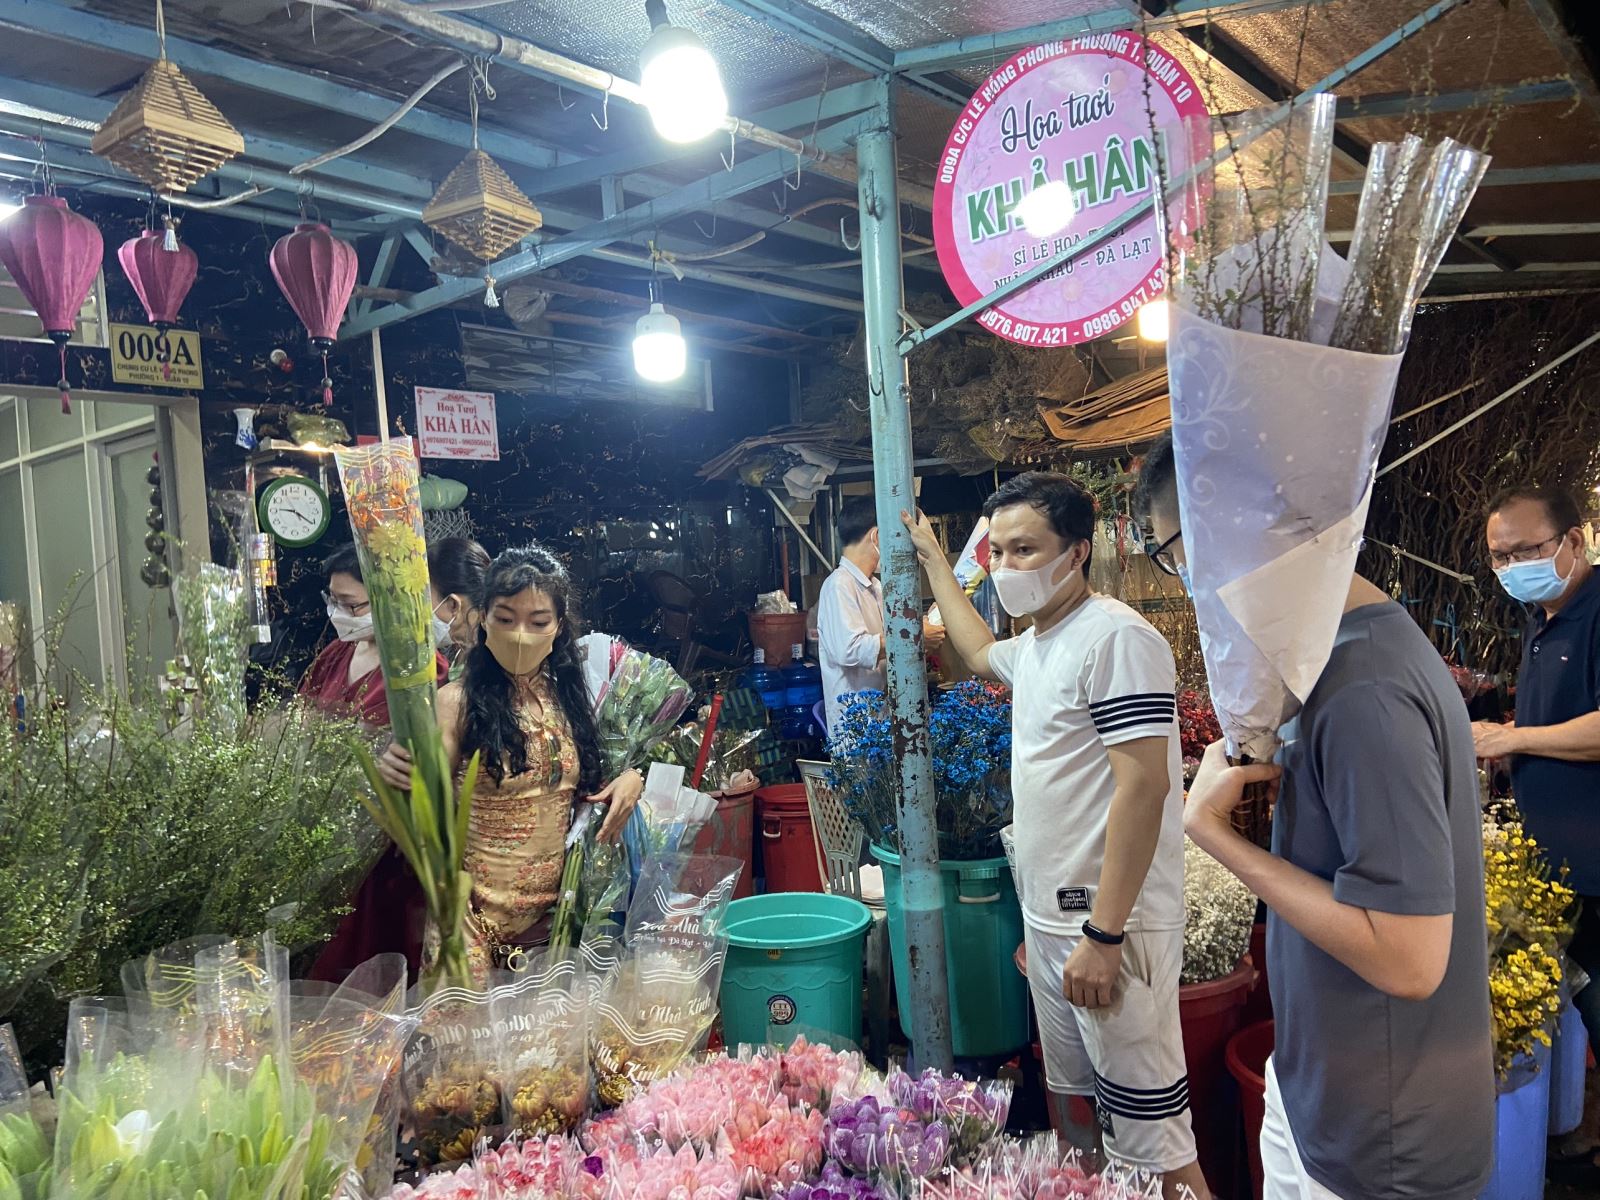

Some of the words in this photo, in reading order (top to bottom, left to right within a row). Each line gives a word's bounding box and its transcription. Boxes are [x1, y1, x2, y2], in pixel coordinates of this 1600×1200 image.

[940, 147, 961, 184] 009A
[953, 118, 973, 145] C/C
[967, 97, 986, 120] LÊ
[1017, 40, 1068, 73] PHONG,
[1172, 80, 1193, 104] 10
[1001, 98, 1062, 153] Hoa
[1062, 74, 1115, 129] tươi
[1065, 136, 1169, 209] HÂN
[1095, 245, 1116, 266] ĐÀ
[1122, 238, 1152, 261] LẠT
[980, 307, 1068, 345] 0976.807.421
[118, 331, 195, 366] 009A
[424, 413, 458, 433] KHẢ
[461, 415, 492, 435] HÂN
